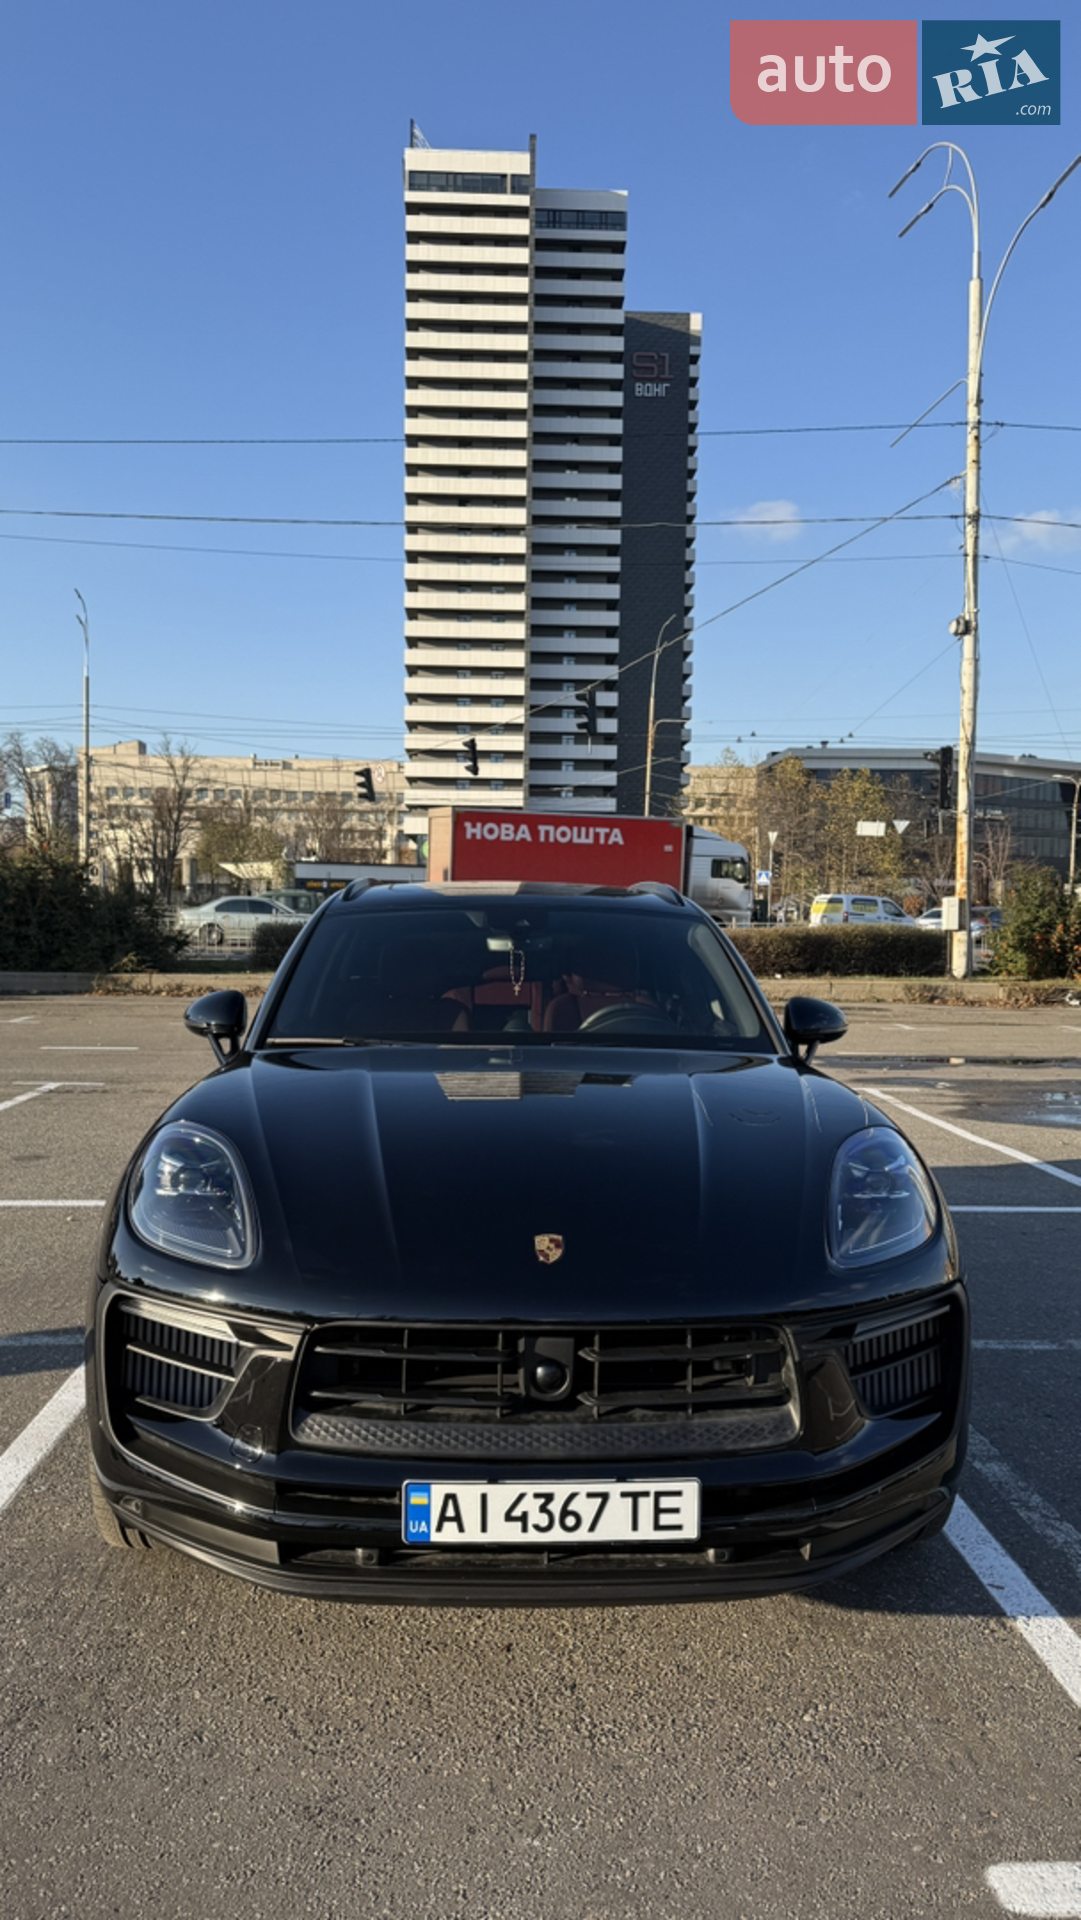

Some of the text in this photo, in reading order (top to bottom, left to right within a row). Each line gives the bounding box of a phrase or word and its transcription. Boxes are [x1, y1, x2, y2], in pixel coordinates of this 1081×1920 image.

[632, 351, 674, 379] S1
[634, 382, 671, 397] ВДНГ
[464, 821, 625, 846] НОВА ПОШТА
[409, 1520, 429, 1533] UA
